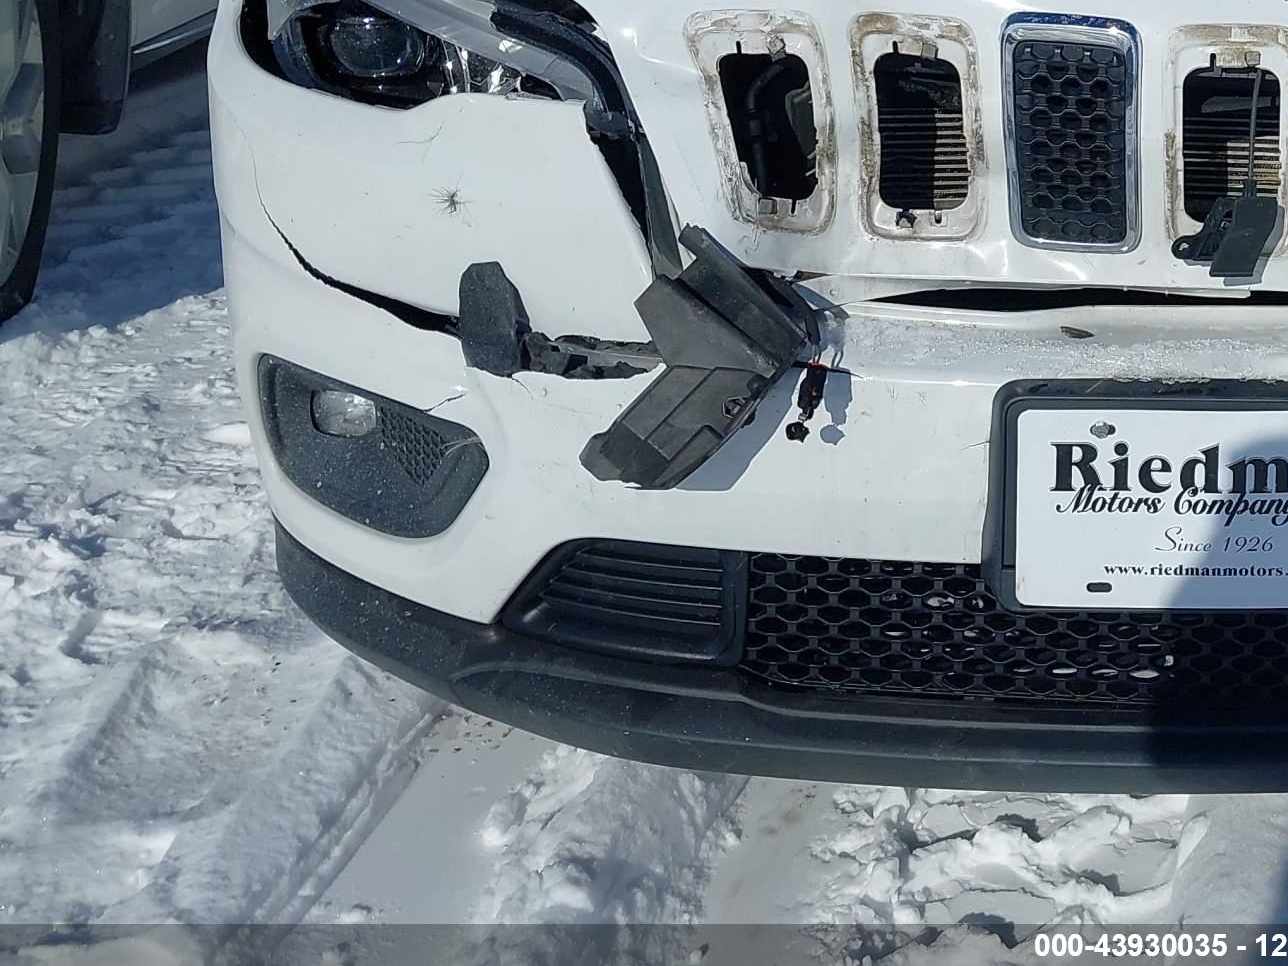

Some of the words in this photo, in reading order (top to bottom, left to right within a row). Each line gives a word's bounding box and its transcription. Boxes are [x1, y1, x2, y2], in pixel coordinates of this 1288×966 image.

[1055, 483, 1166, 514] Motors
[1154, 526, 1212, 553] Since
[1223, 535, 1275, 553] 1926
